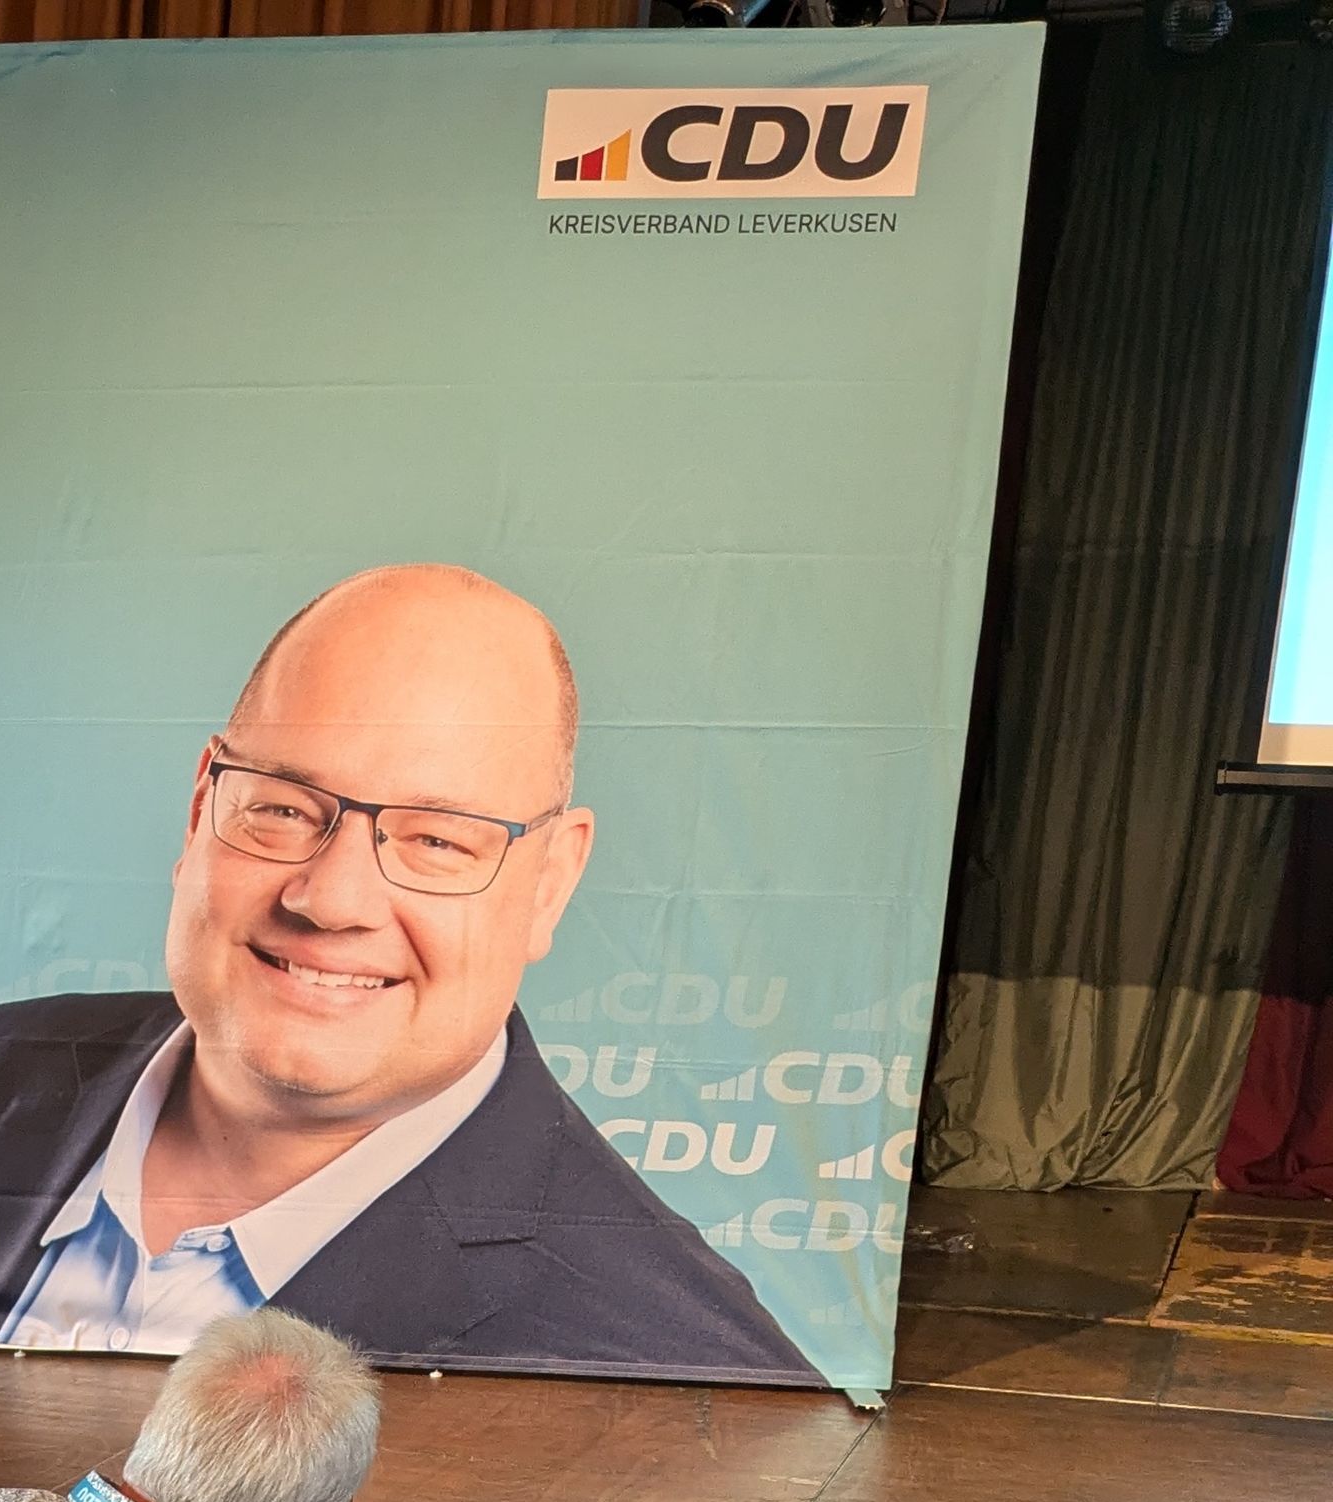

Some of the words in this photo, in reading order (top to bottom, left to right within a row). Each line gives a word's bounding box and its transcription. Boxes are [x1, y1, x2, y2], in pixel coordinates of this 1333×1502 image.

[640, 102, 910, 183] CDU
[548, 213, 730, 235] KREISVERBAND
[738, 212, 898, 234] LEVERKUSEN
[599, 971, 789, 1029] CDU
[535, 1043, 658, 1098] DU
